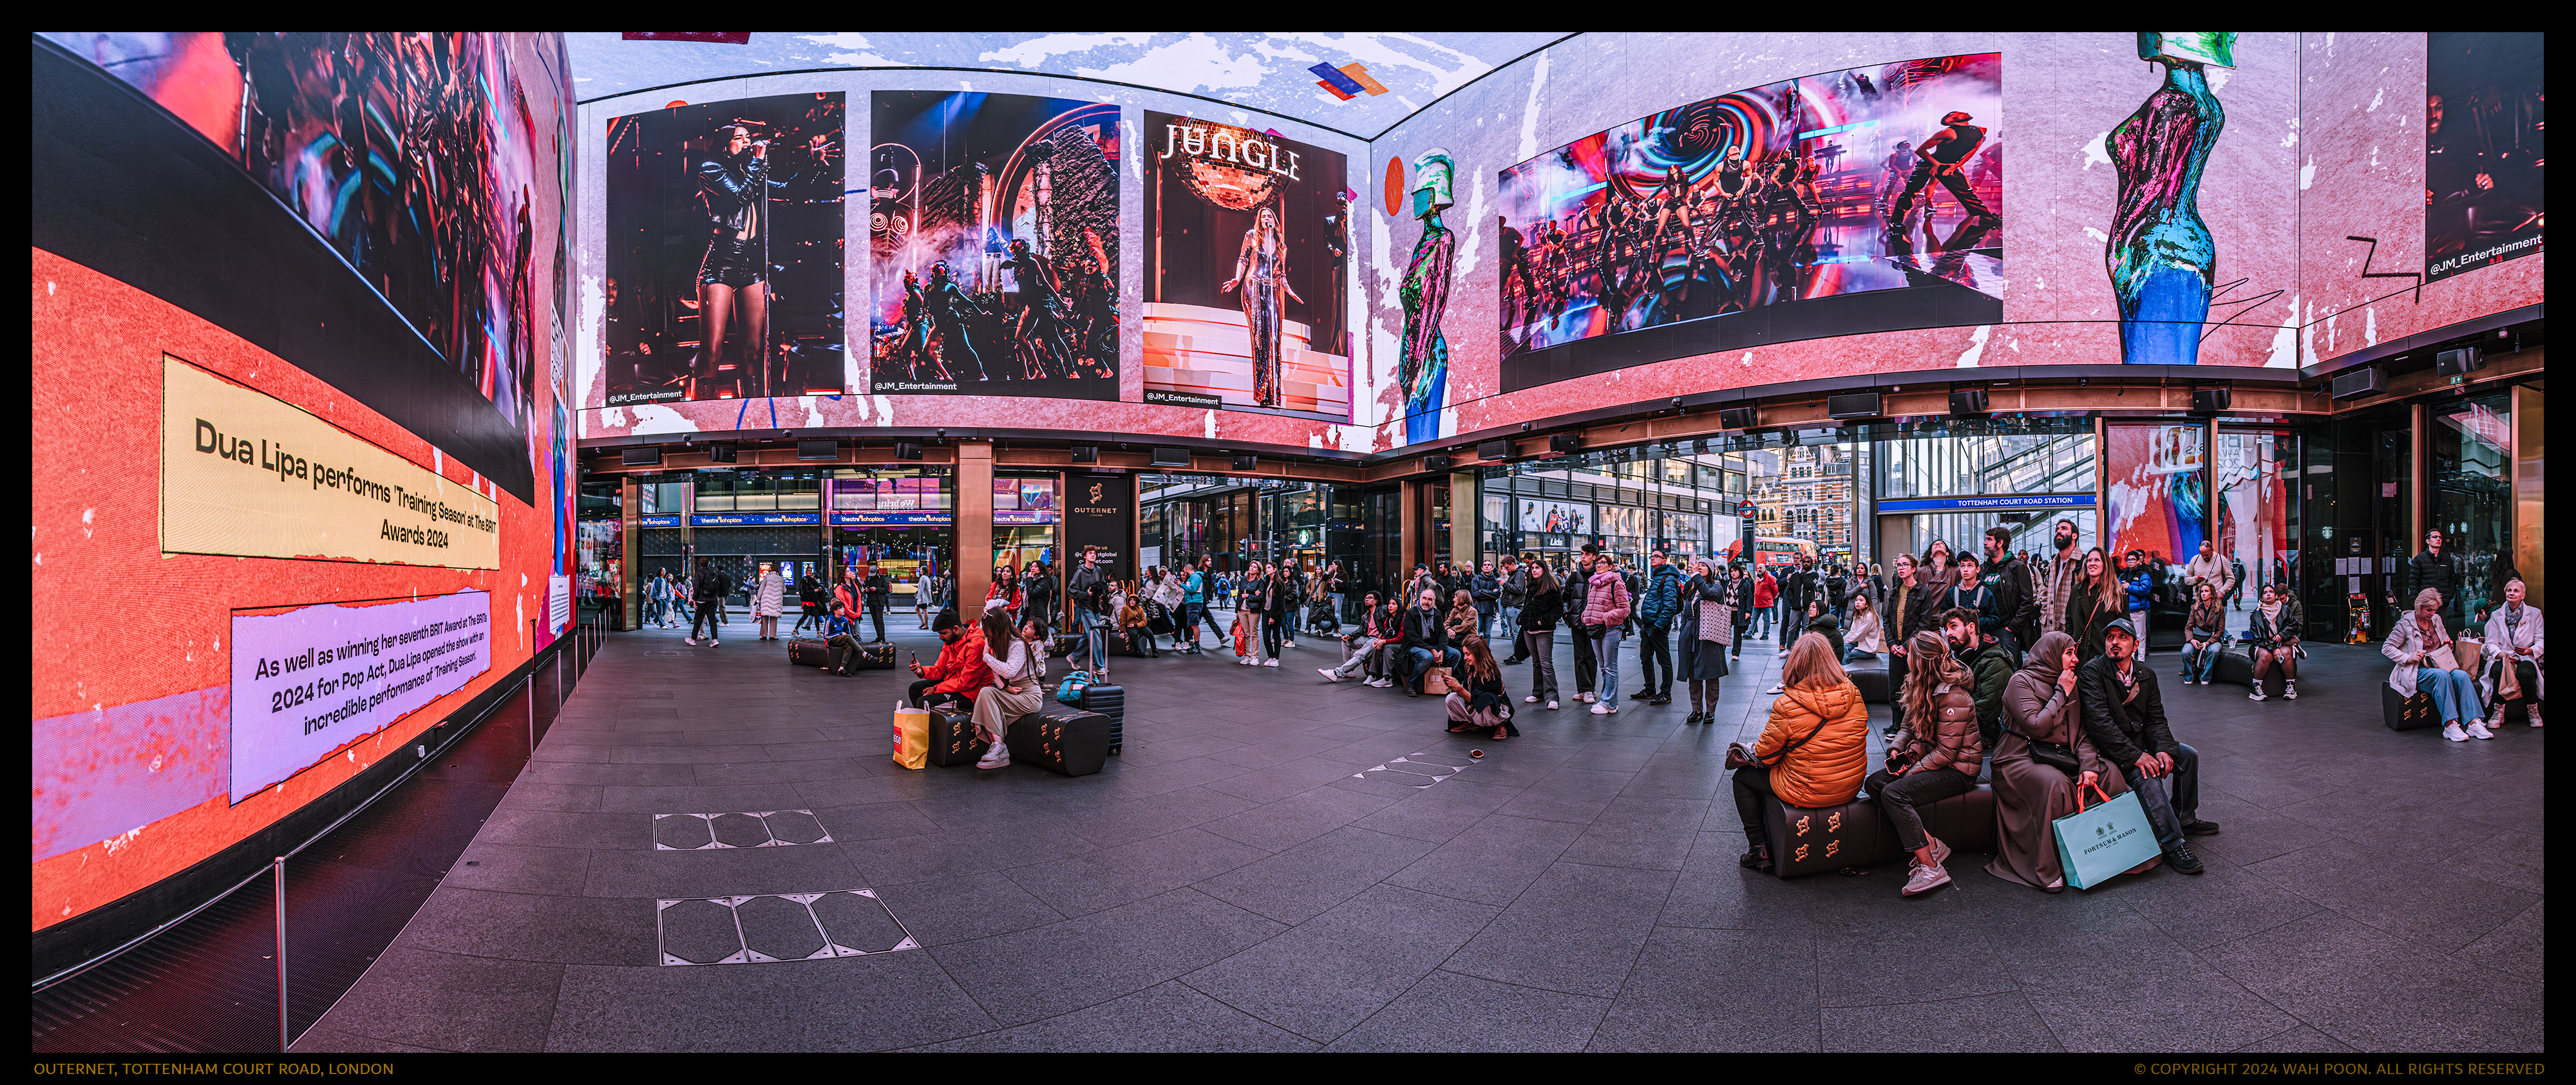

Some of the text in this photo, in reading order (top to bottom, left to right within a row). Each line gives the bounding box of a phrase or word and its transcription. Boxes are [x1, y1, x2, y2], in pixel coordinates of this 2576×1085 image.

[1160, 124, 1300, 182] JUNGLE
[2430, 234, 2543, 275] @JM_Entertainment
[609, 390, 683, 403] @JM_Entertainment
[875, 382, 957, 391] @JM_Entertainment
[1147, 393, 1218, 405] @JM_Entertainment
[196, 417, 496, 534] Dua Lipa performs 'Training Season' at The BRIT
[381, 518, 448, 549] Awards 2024
[255, 613, 488, 681] As well as winning her seventh BRIT Award at The BRITs
[272, 632, 484, 713] 2024 for Pop Act, Dua Lipa opened the show with an
[304, 696, 367, 736] incredible
[369, 675, 425, 713] performance
[426, 667, 433, 683] of
[434, 659, 458, 678] 'Training
[2084, 839, 2112, 854] FORTNUM
[2117, 827, 2137, 840] MASON
